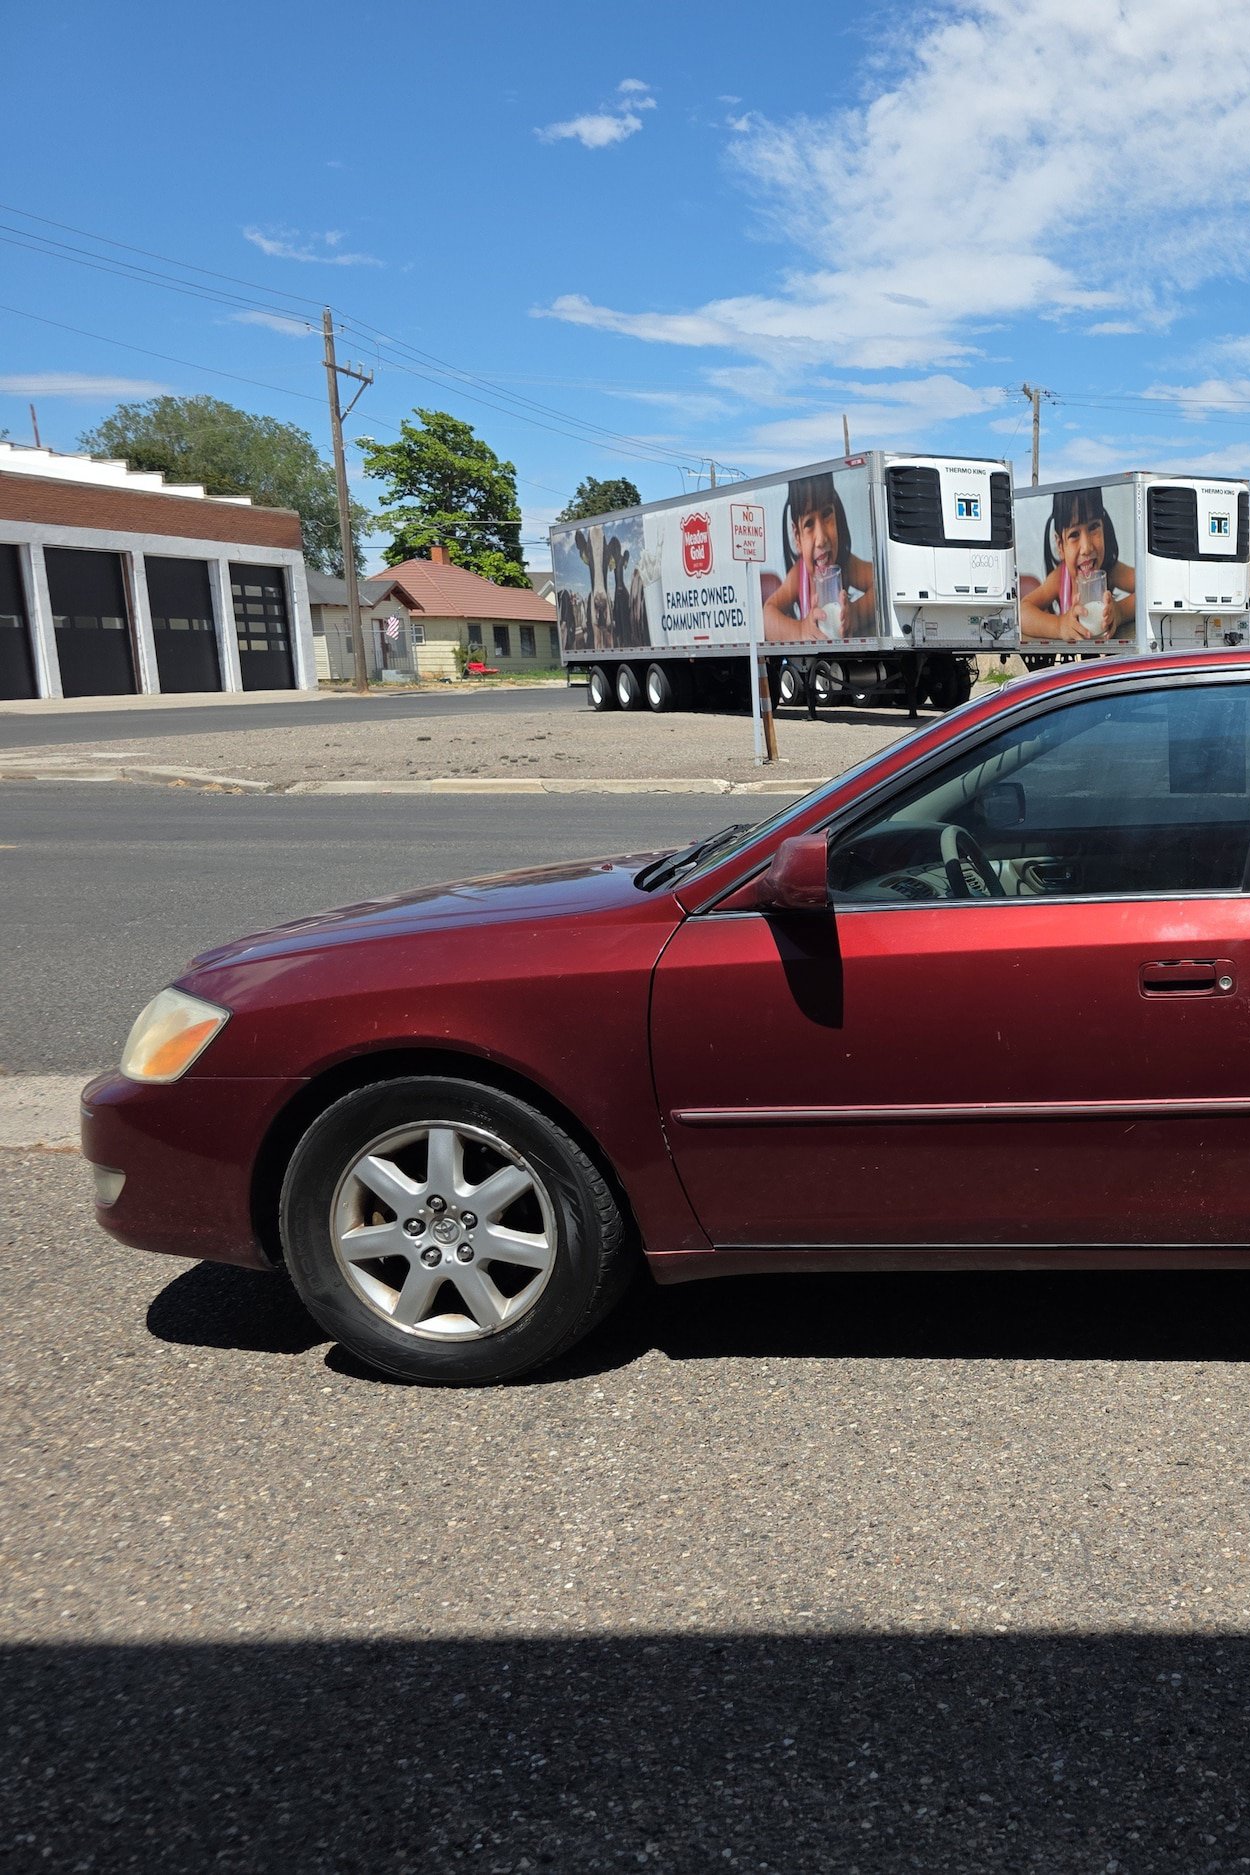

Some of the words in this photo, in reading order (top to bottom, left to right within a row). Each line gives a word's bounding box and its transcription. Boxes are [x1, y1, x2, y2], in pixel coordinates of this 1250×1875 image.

[945, 467, 972, 475] THERMO
[742, 511, 754, 522] NO
[684, 529, 708, 547] Meadow
[734, 525, 763, 538] PARKING
[743, 540, 756, 548] ANY
[690, 544, 705, 560] Gold
[743, 548, 757, 556] TIME
[666, 589, 700, 609] FARMER
[700, 585, 738, 606] OWNED.
[661, 611, 712, 631] COMMUNITY
[714, 608, 747, 628] LOVED.
